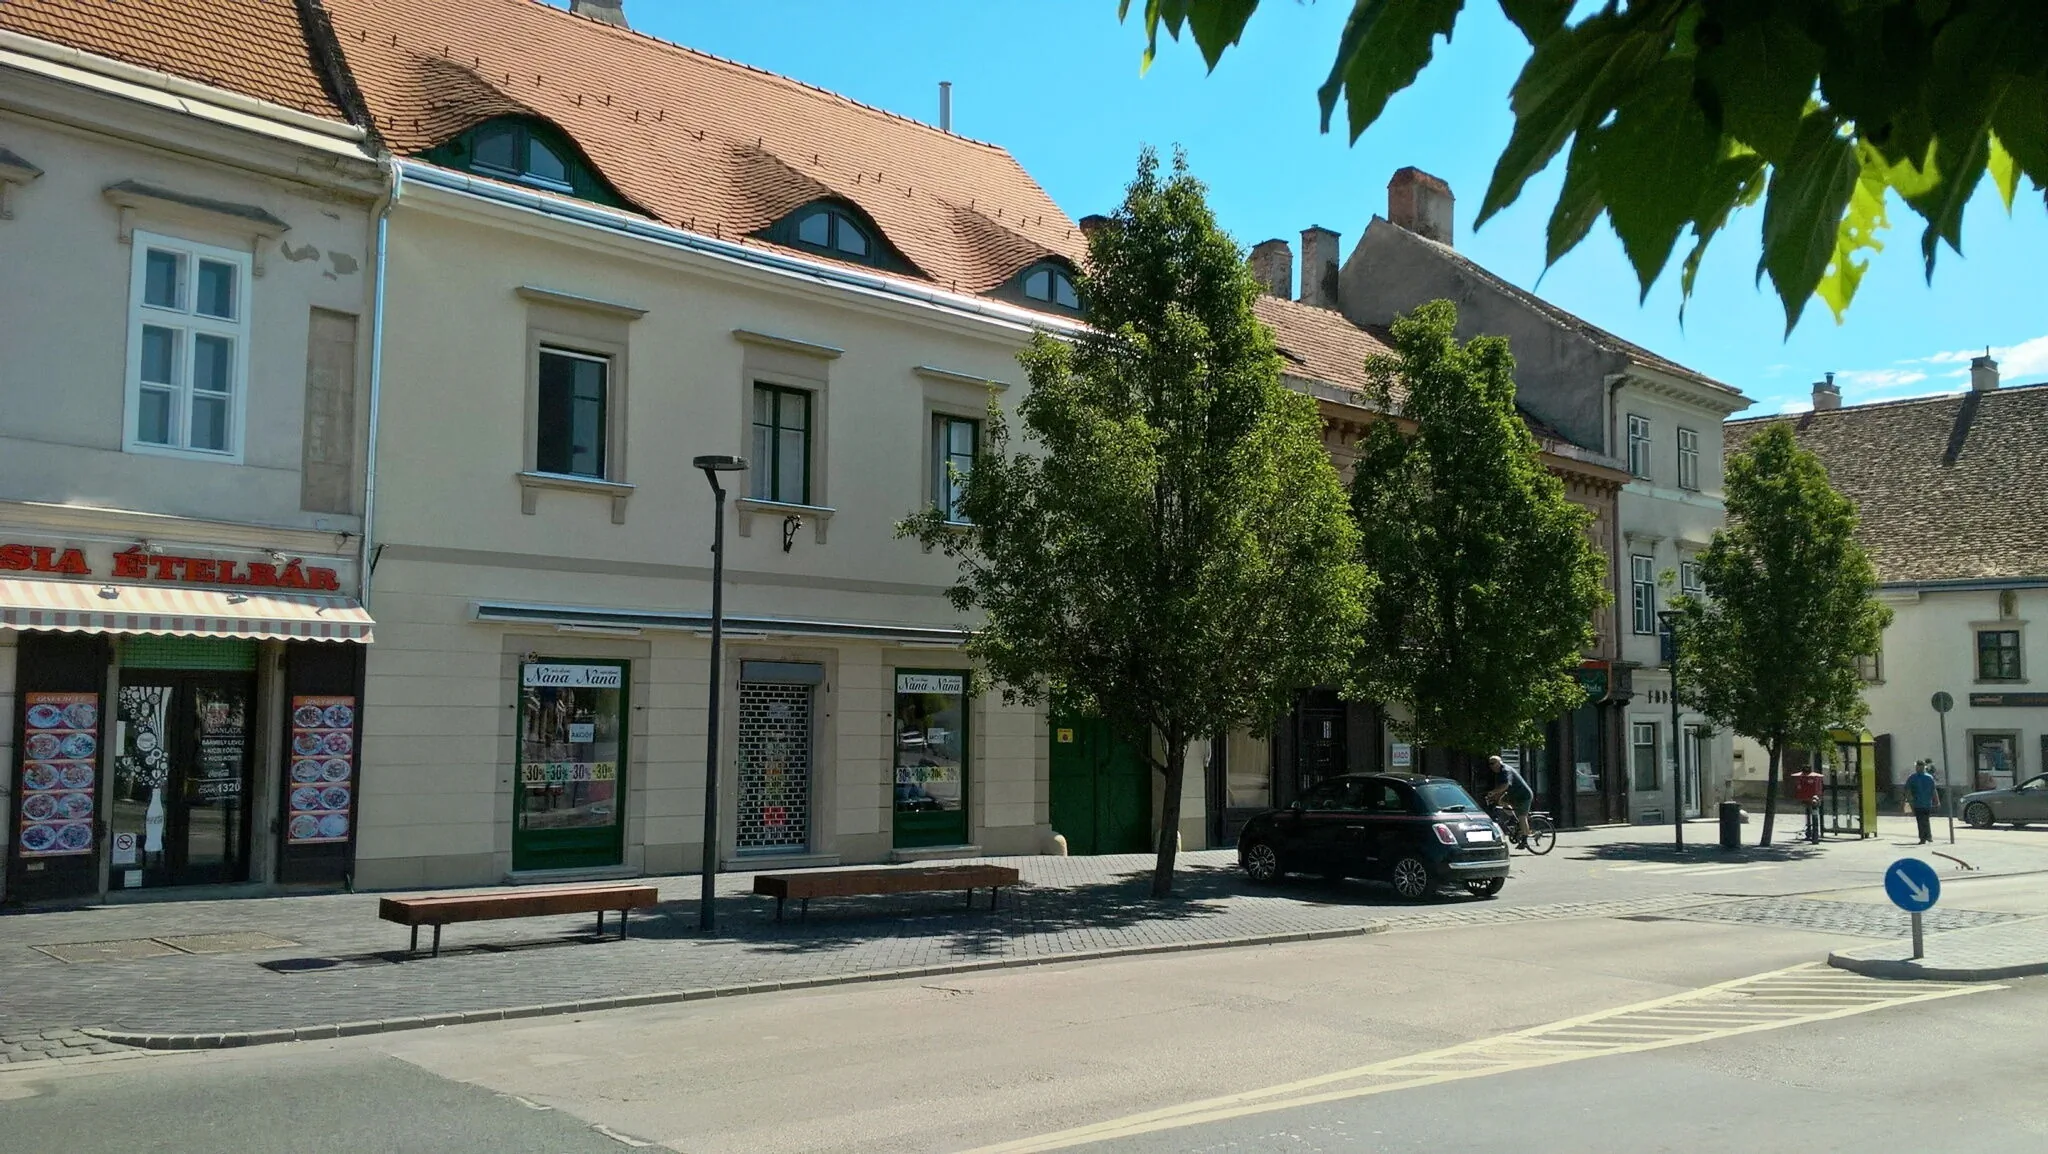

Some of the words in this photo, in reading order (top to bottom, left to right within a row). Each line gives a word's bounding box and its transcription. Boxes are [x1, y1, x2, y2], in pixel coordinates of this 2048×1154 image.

[111, 545, 341, 591] ÉTELBÁR
[526, 667, 571, 684] Nana
[576, 668, 618, 685] Nana
[898, 677, 928, 691] Nana
[931, 678, 961, 692] Nana
[522, 764, 545, 781] -30%
[217, 783, 240, 792] 1320
